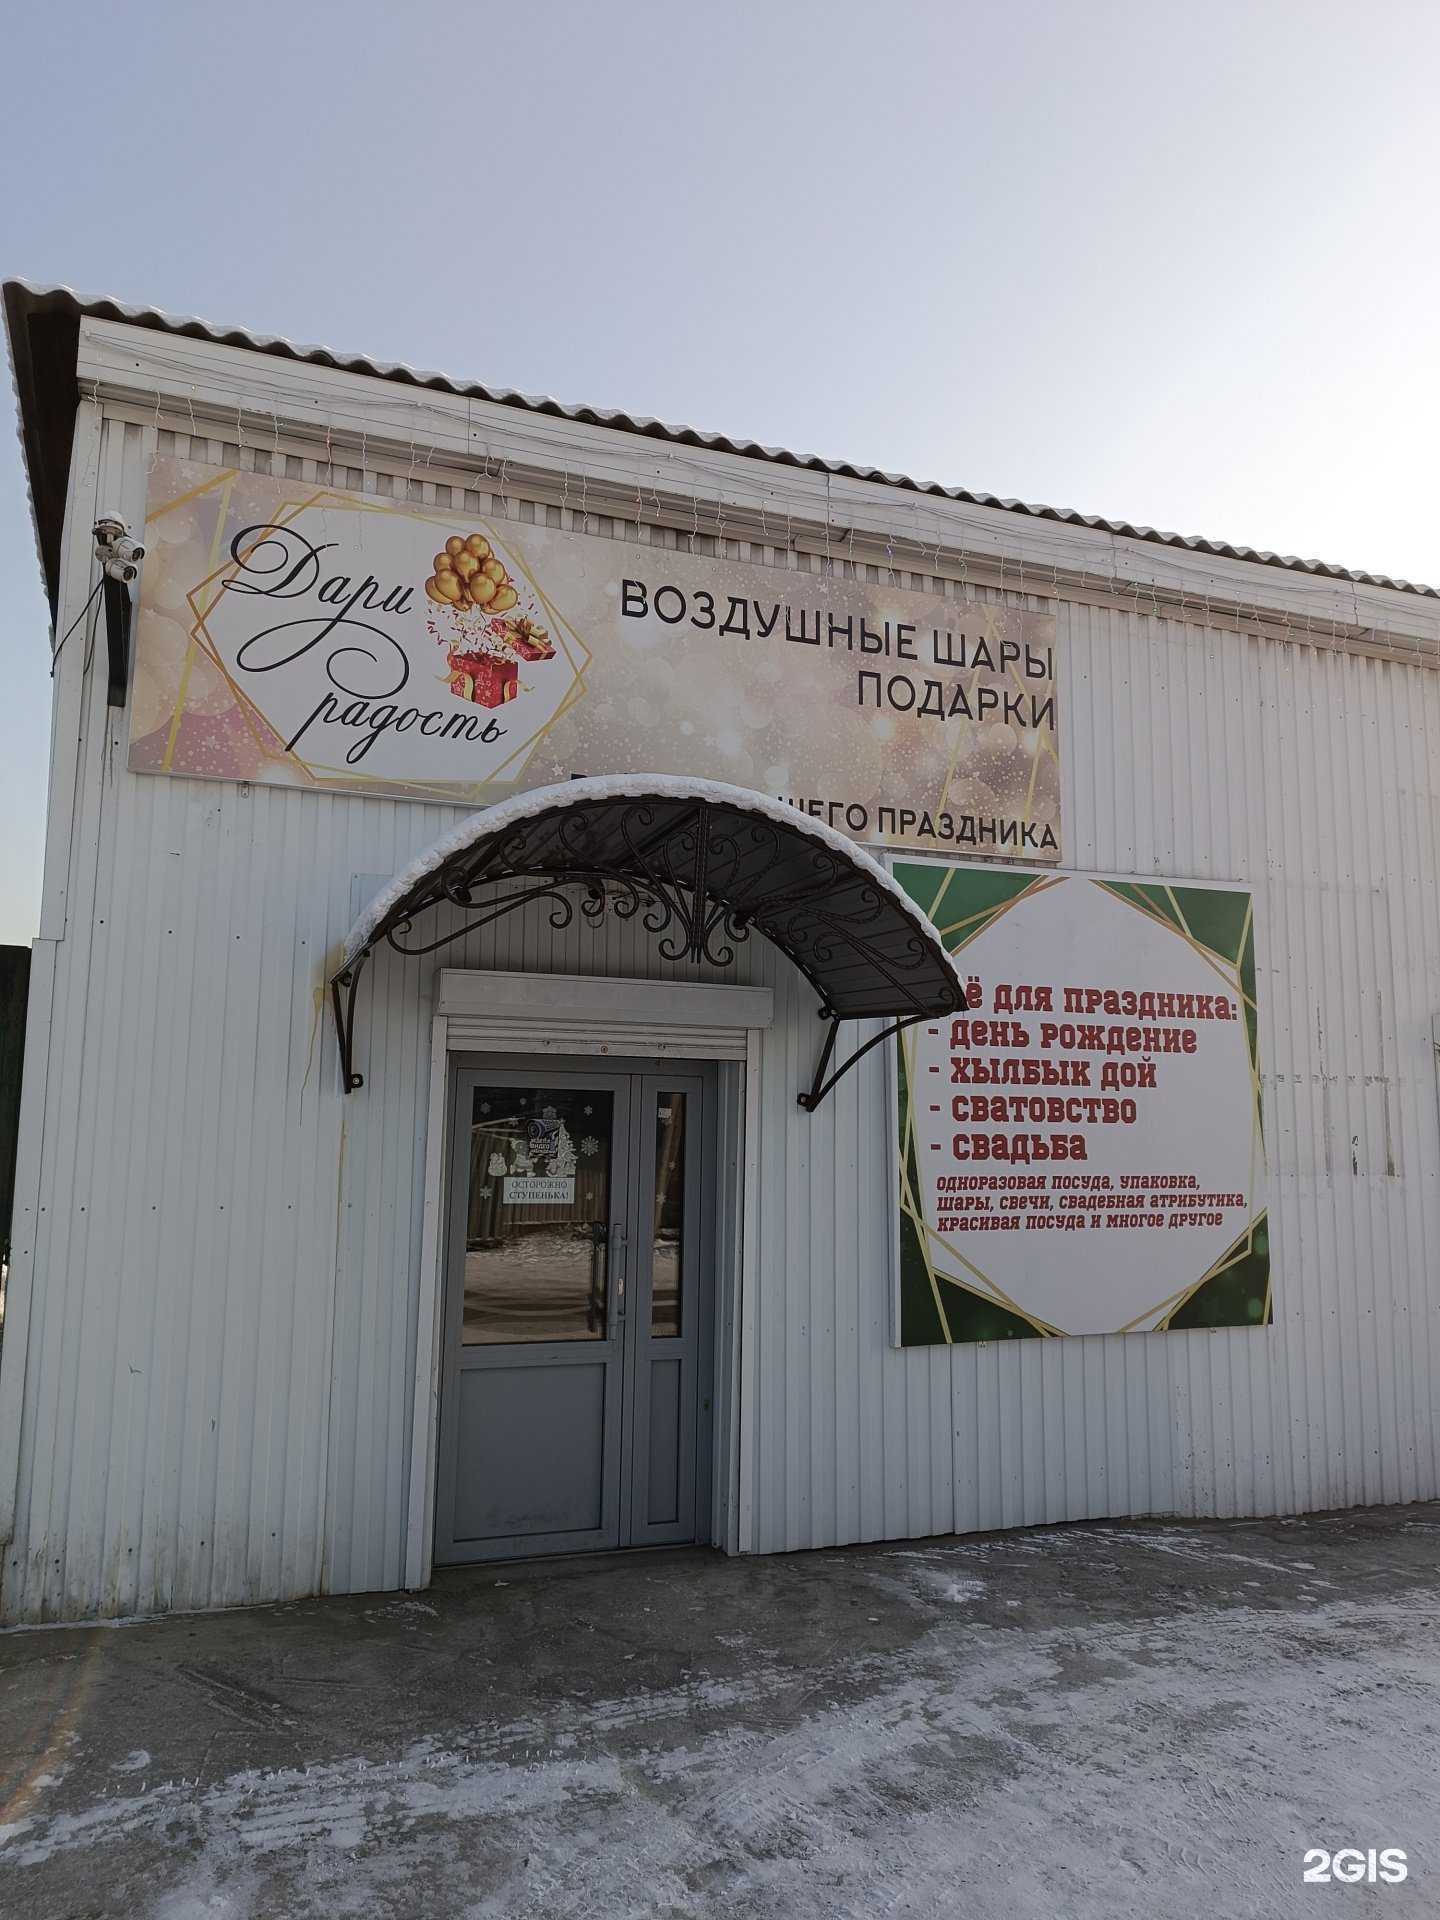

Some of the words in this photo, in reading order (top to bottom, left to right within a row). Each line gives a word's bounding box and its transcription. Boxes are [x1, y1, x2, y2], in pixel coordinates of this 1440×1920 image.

[221, 524, 413, 690] Дари
[621, 578, 918, 660] ВОЗДУШНЫЕ
[933, 629, 1053, 680] ШАРЫ
[285, 691, 507, 764] радость
[858, 671, 1055, 731] ПОДАРКИ
[878, 806, 1059, 849] ПРАЗДНИКА
[511, 1180, 568, 1189] ОСТОРОЖНО
